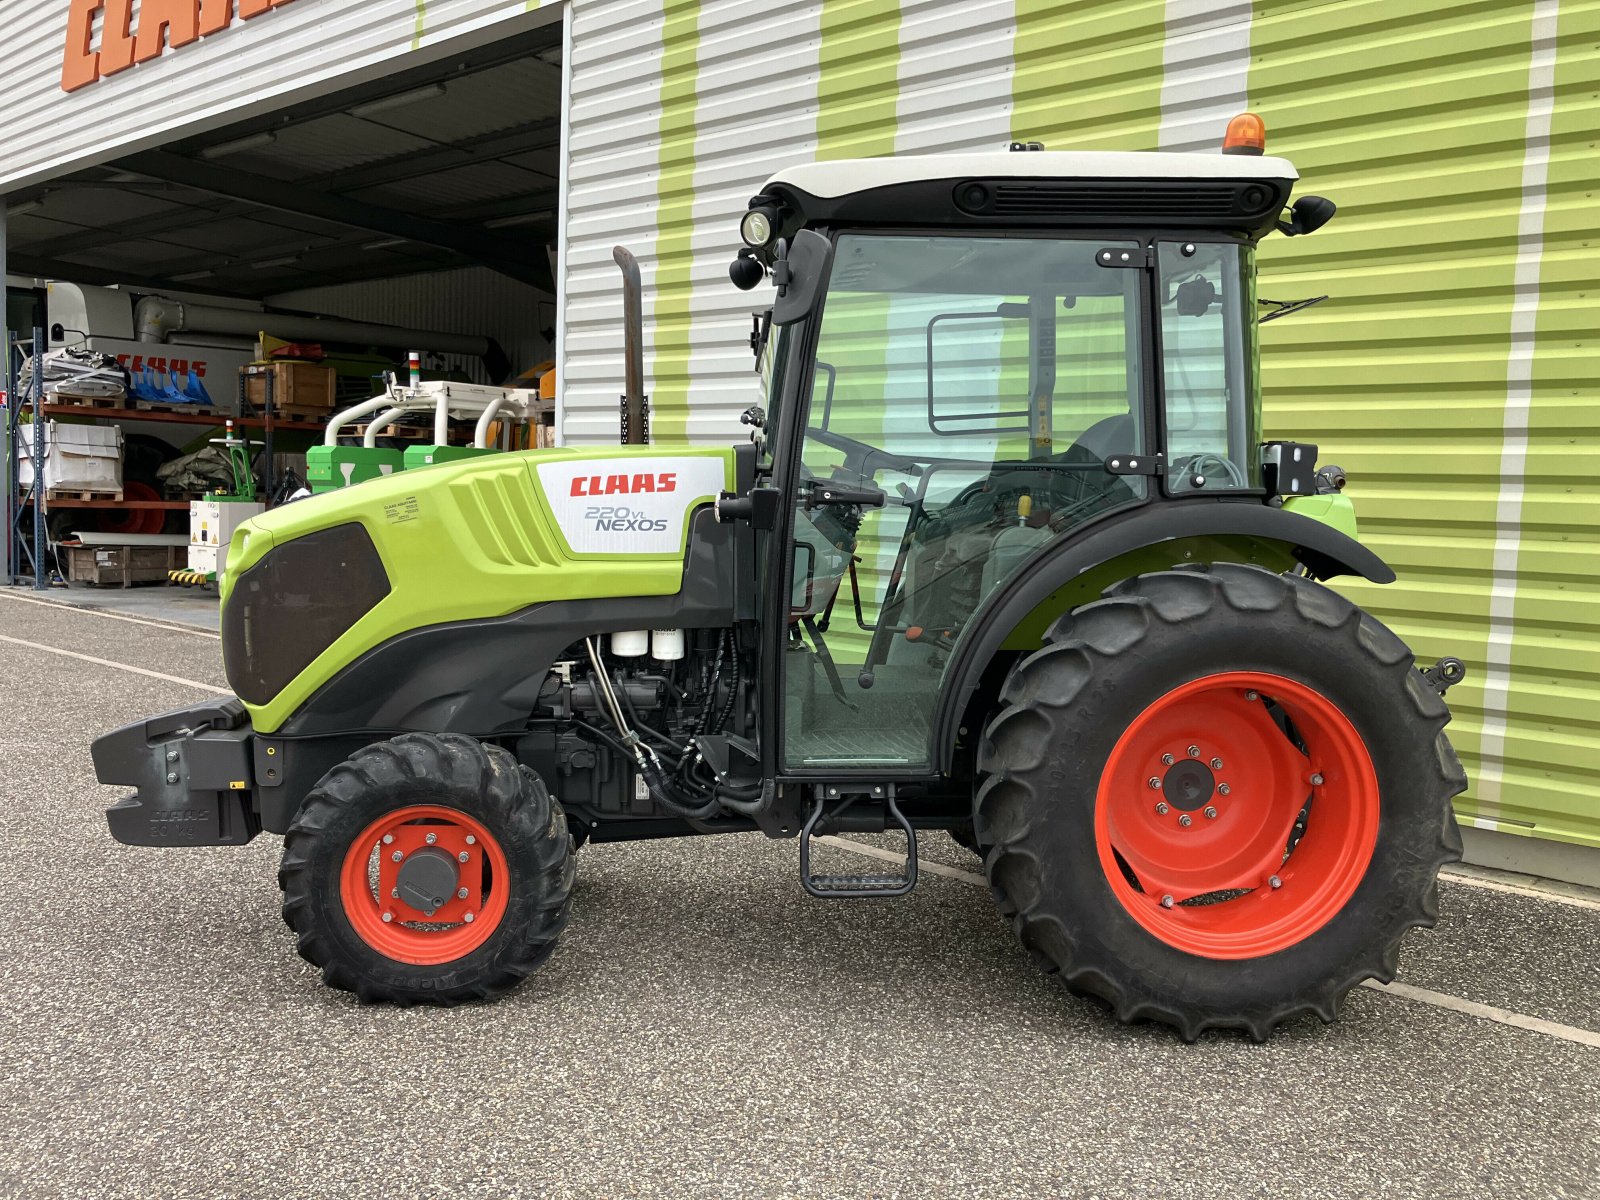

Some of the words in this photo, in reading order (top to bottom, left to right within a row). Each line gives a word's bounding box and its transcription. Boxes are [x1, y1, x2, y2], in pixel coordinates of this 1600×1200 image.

[61, 0, 296, 93] CLA
[116, 353, 208, 378] CLAAS
[570, 473, 677, 497] CLAAS
[584, 506, 630, 520] 220
[631, 511, 647, 520] VL
[595, 519, 668, 532] NEXOS
